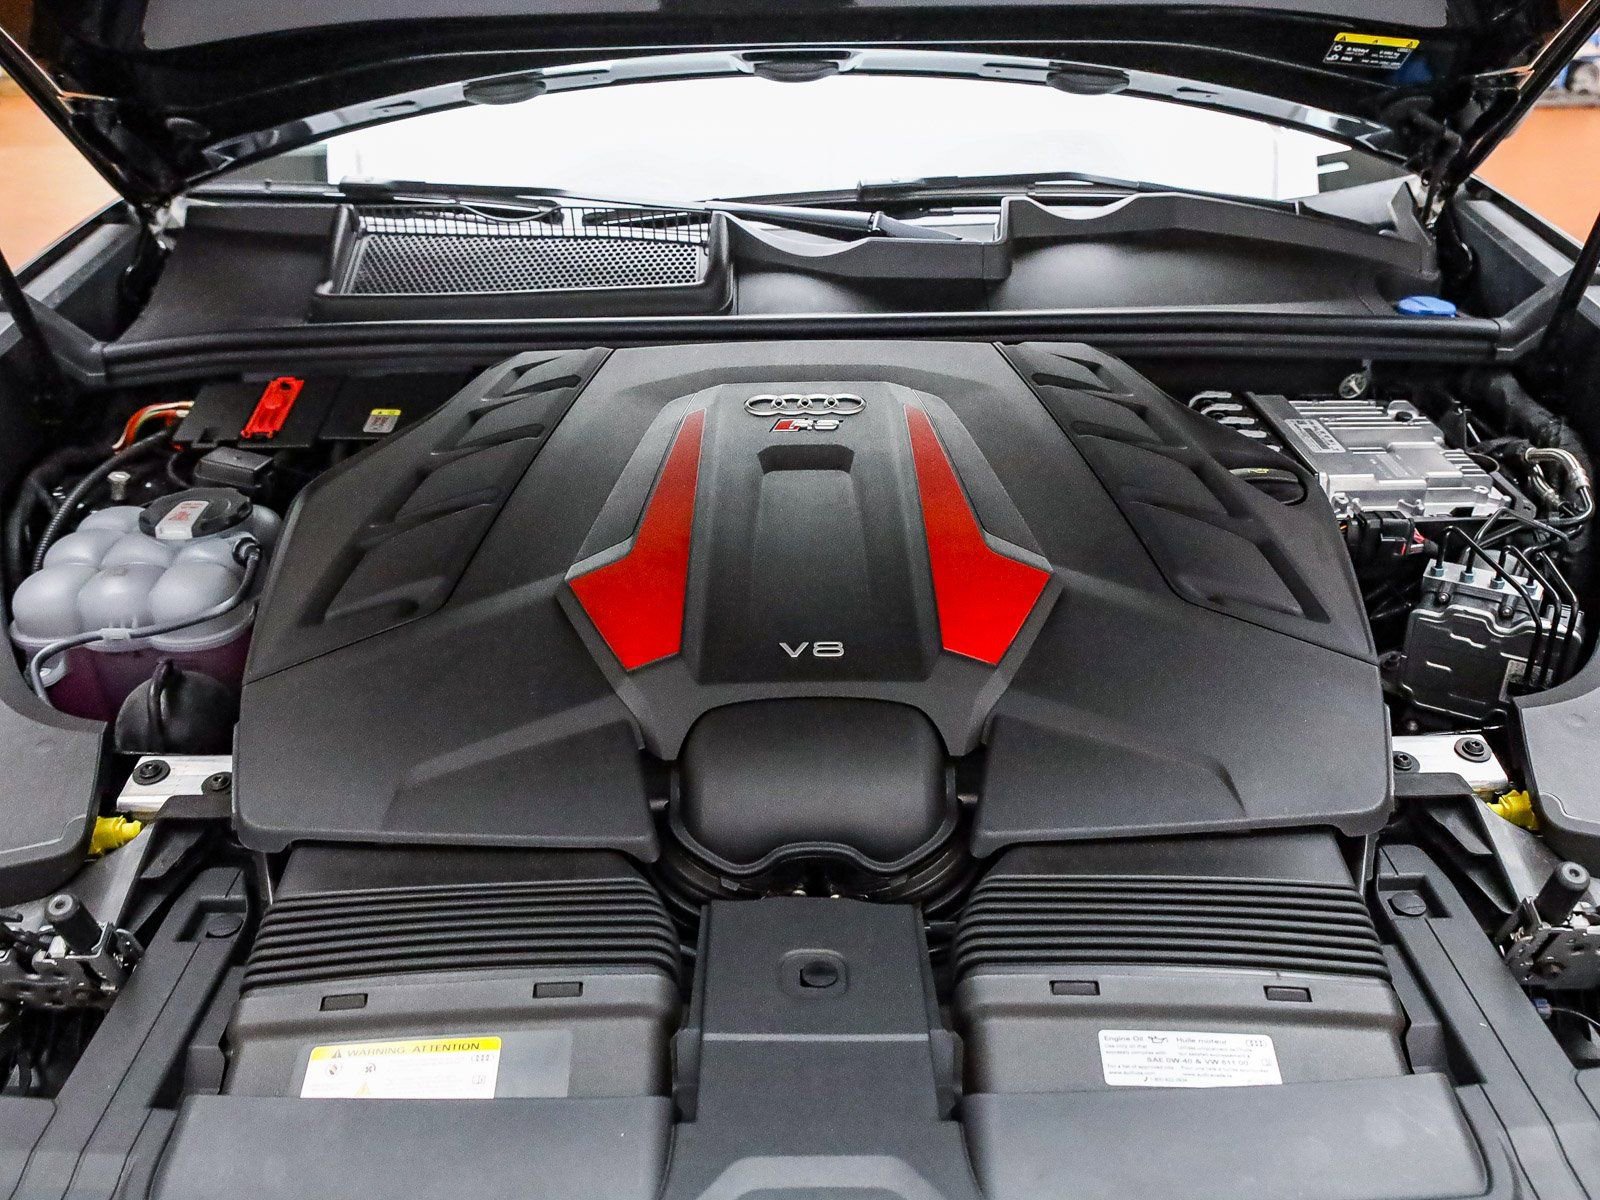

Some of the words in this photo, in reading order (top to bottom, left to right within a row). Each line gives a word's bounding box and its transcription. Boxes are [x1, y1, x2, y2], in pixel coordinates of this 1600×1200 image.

[780, 418, 841, 432] RS
[779, 641, 845, 658] V8
[1104, 1035, 1131, 1043] Engine
[346, 1046, 406, 1057] WARNING
[411, 1042, 481, 1053] ATTENTION
